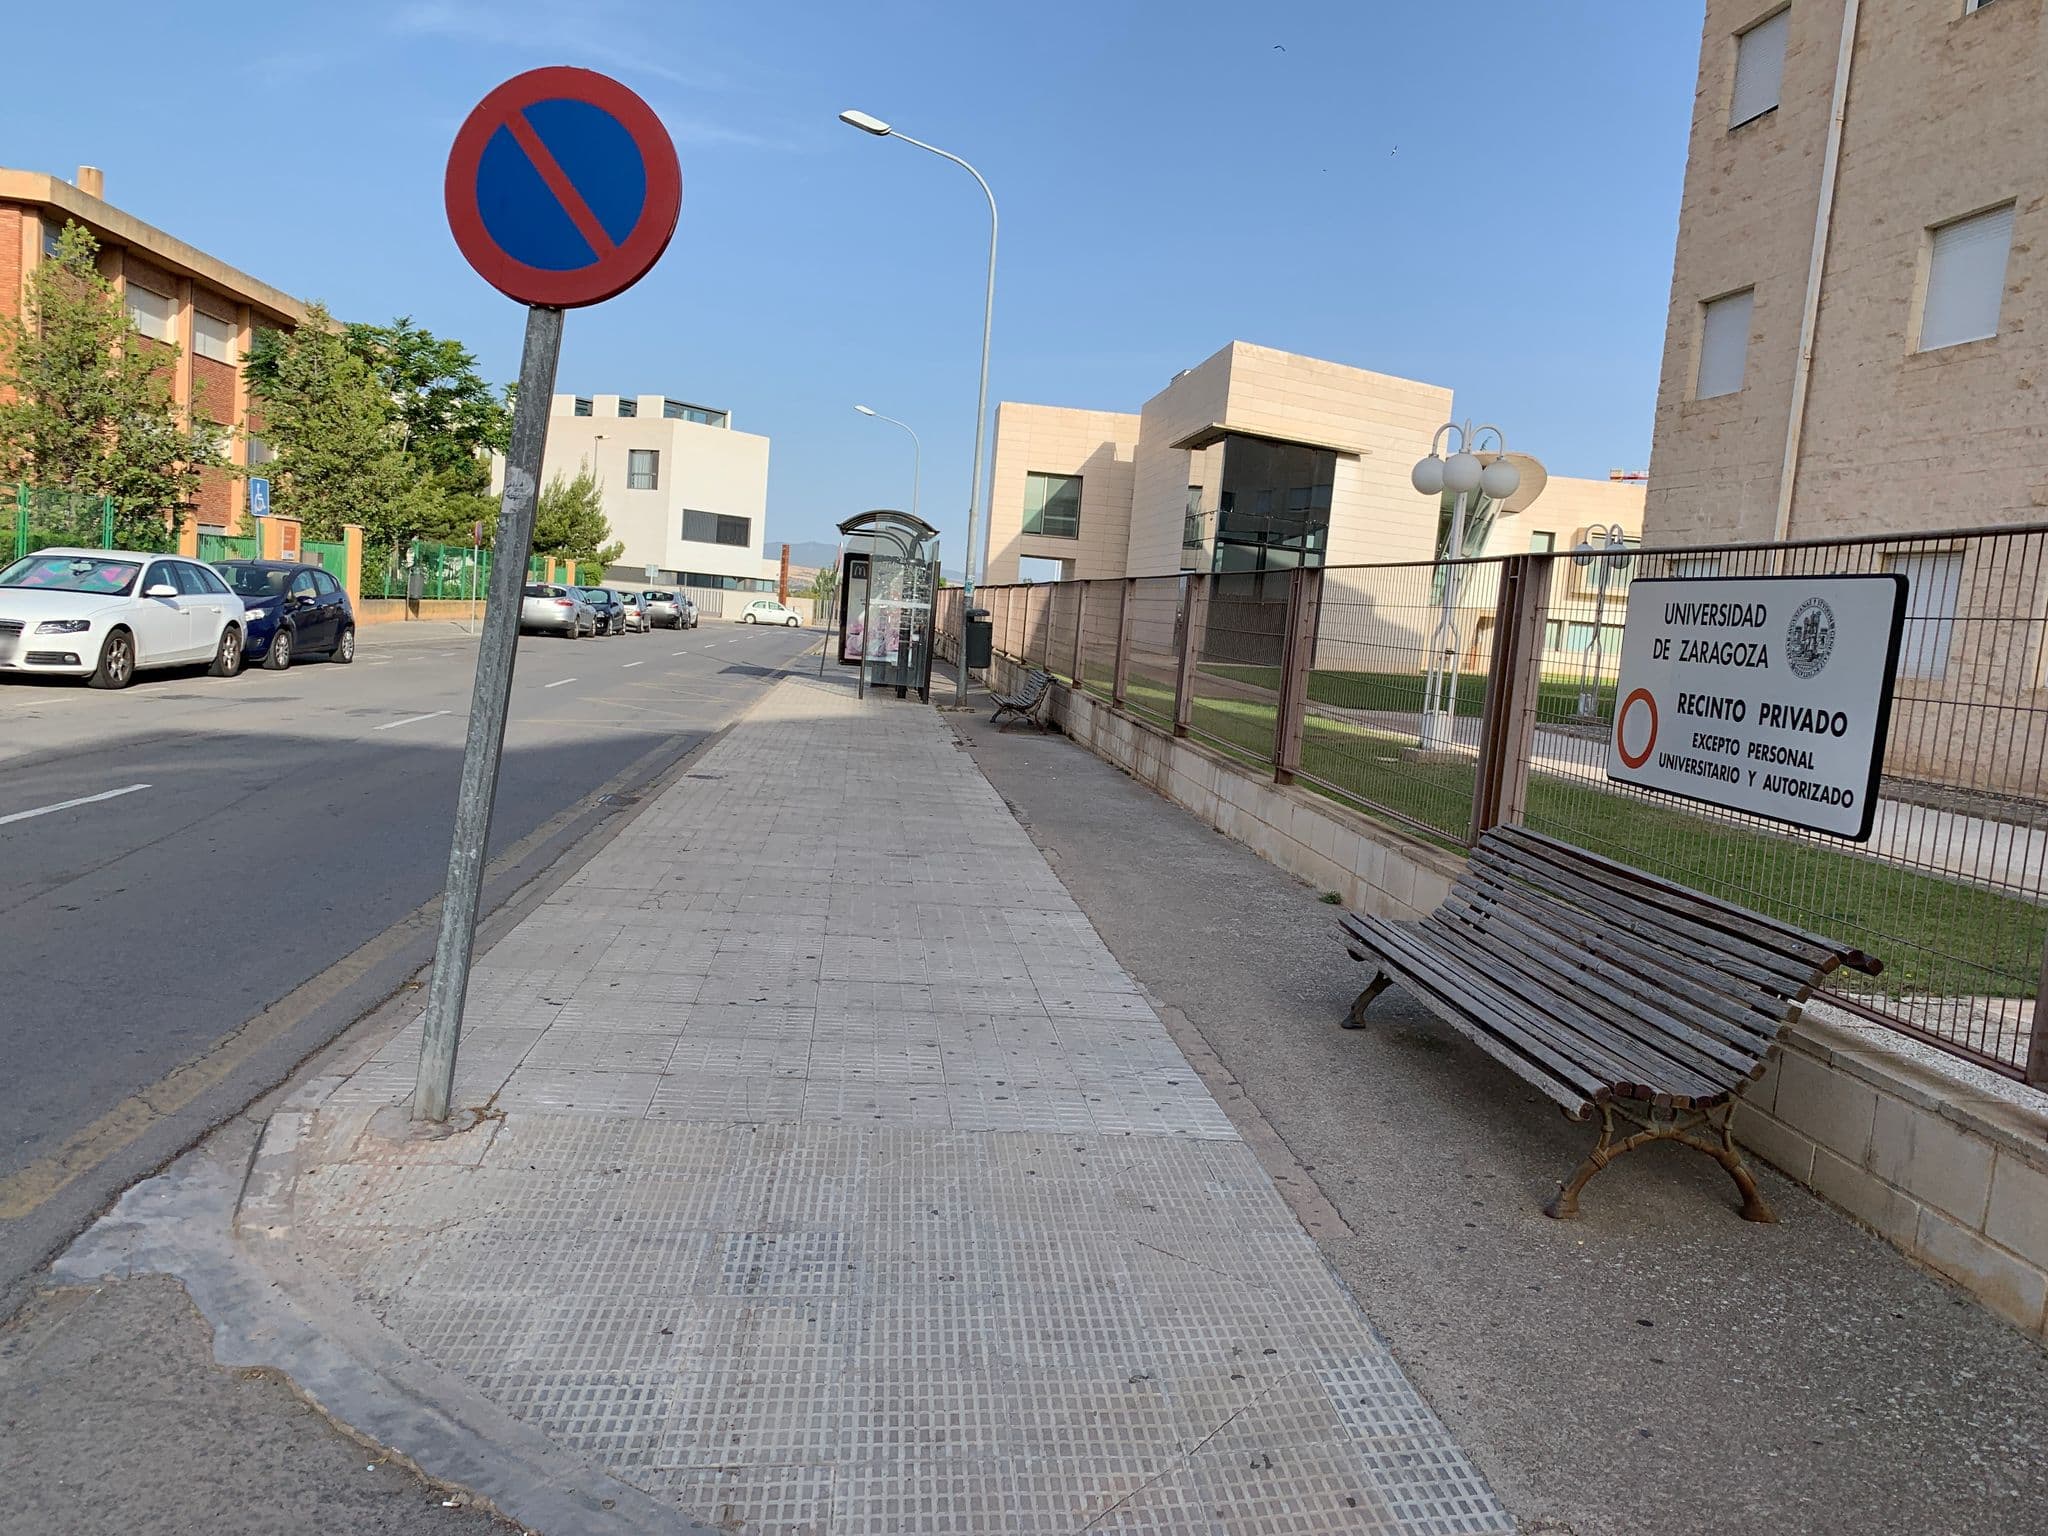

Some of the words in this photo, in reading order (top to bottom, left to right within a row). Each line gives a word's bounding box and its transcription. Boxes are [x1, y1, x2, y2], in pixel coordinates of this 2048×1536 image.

[1664, 603, 1767, 628] UNIVERSIDAD
[1653, 638, 1671, 660] DE
[1679, 640, 1769, 669] ZARAGOZA
[1677, 692, 1746, 723] RECINTO
[1758, 703, 1848, 737] PRIVADO
[1692, 732, 1740, 756] EXCEPTO
[1747, 742, 1814, 770] PERSONAL
[1659, 752, 1740, 784] UNIVERSITARIO
[1748, 770, 1757, 787] Y
[1763, 774, 1854, 809] AUTORIZADO
